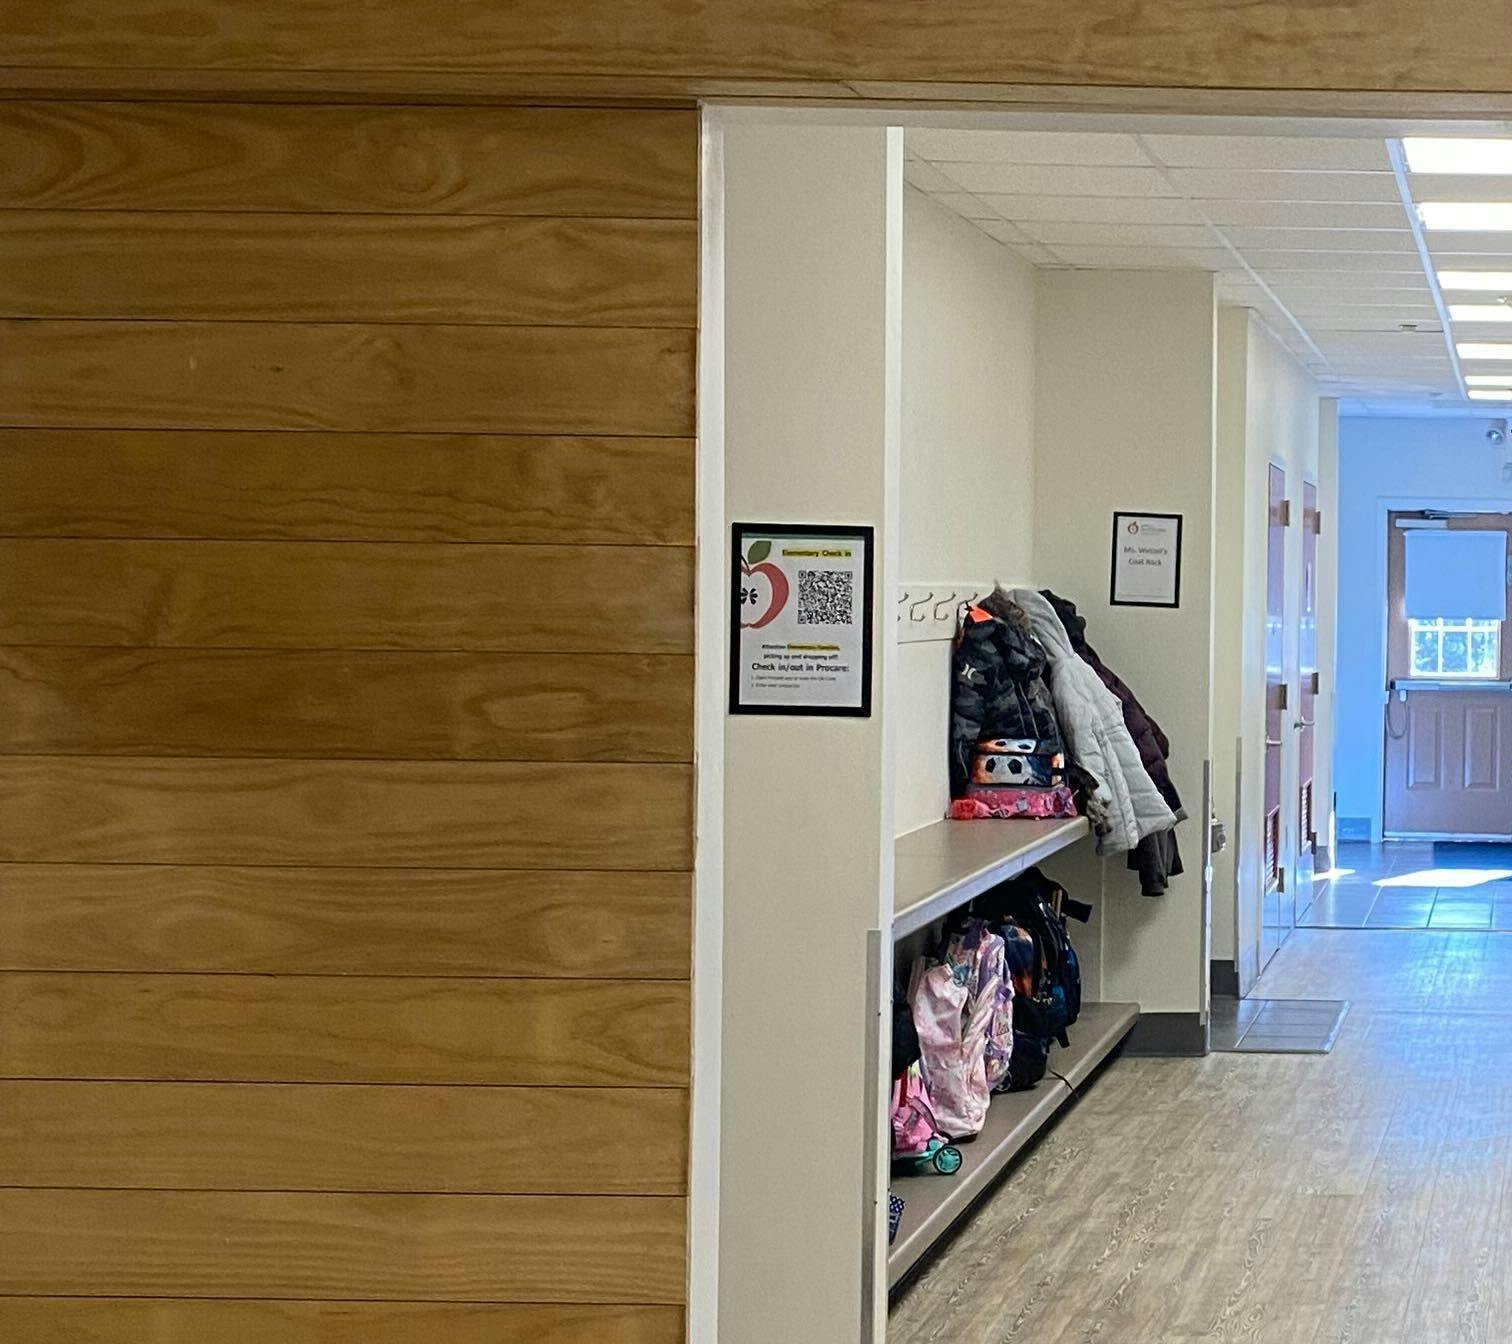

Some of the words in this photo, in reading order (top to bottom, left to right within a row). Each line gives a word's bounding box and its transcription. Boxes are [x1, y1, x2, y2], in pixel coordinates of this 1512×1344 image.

[751, 662, 775, 671] Check
[778, 663, 804, 672] in/out
[806, 663, 814, 671] in
